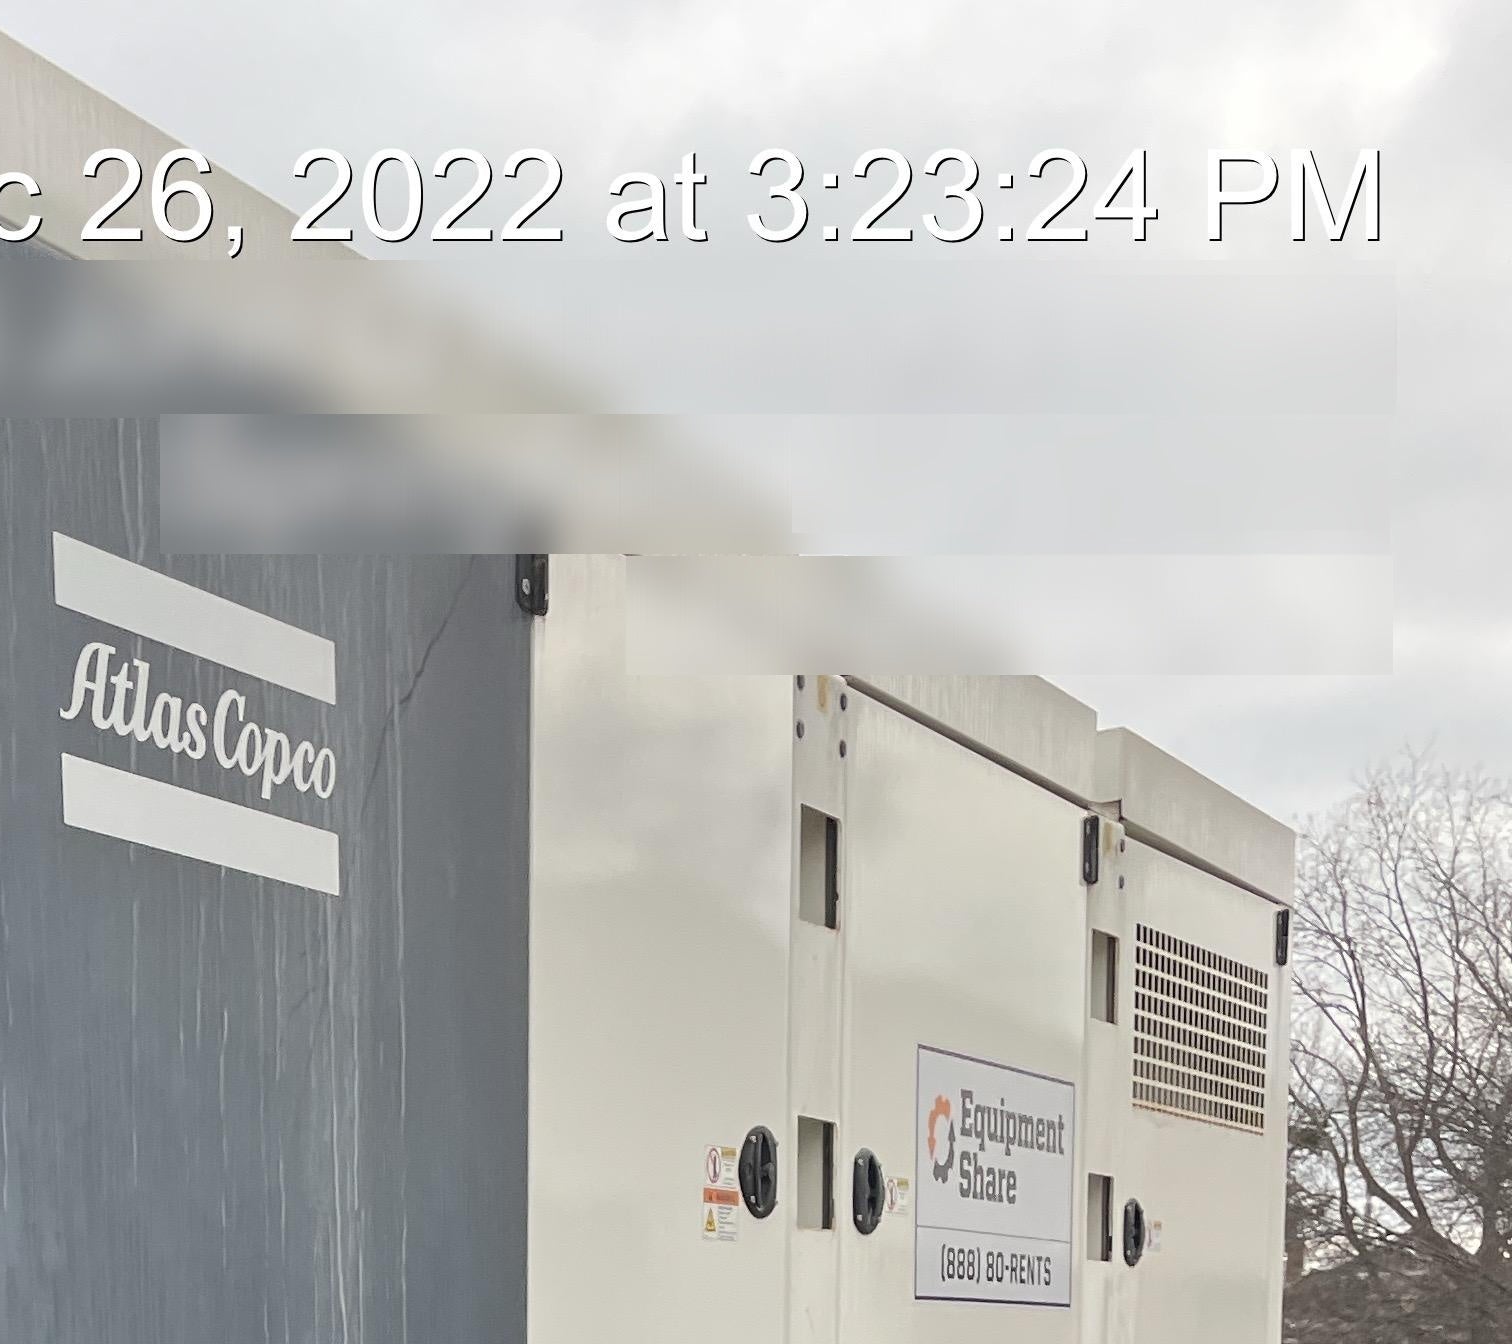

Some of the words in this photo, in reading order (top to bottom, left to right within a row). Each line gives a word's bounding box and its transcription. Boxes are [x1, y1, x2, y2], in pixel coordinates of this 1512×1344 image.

[59, 641, 208, 760] Atlas
[213, 689, 336, 800] Copco
[959, 1088, 1065, 1156] Equipment
[958, 1150, 1017, 1204] Share
[941, 1244, 981, 1284] (888)
[986, 1250, 1052, 1286] 80-RENTS
